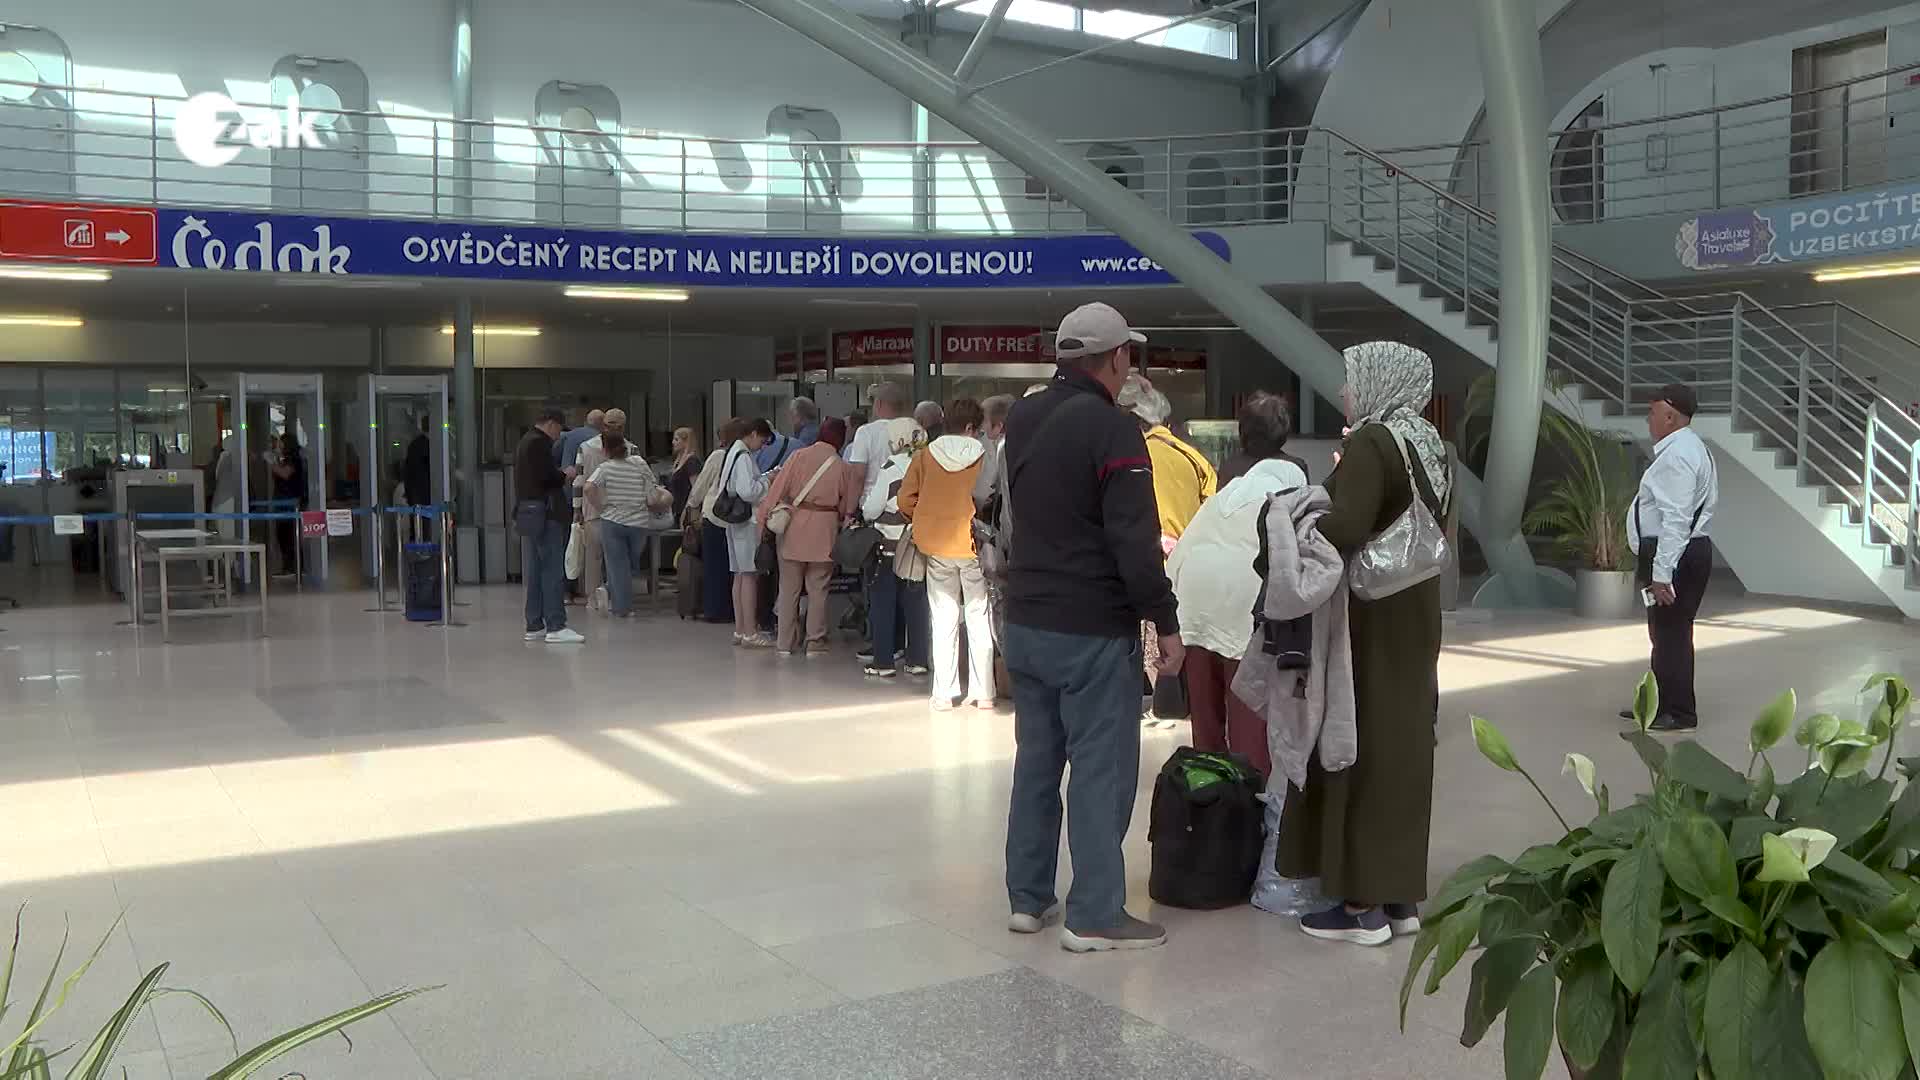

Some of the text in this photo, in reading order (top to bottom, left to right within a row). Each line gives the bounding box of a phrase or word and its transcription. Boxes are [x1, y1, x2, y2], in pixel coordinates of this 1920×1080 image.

[1701, 227, 1751, 243] Asialuxe
[172, 215, 351, 275] Čedok
[402, 231, 1034, 275] OSVĚDČENÝ RECEPT NA NEJLEPŠÍ DOVOLENOU!
[946, 336, 1035, 353] DUTY FREE
[303, 523, 326, 532] STOP
